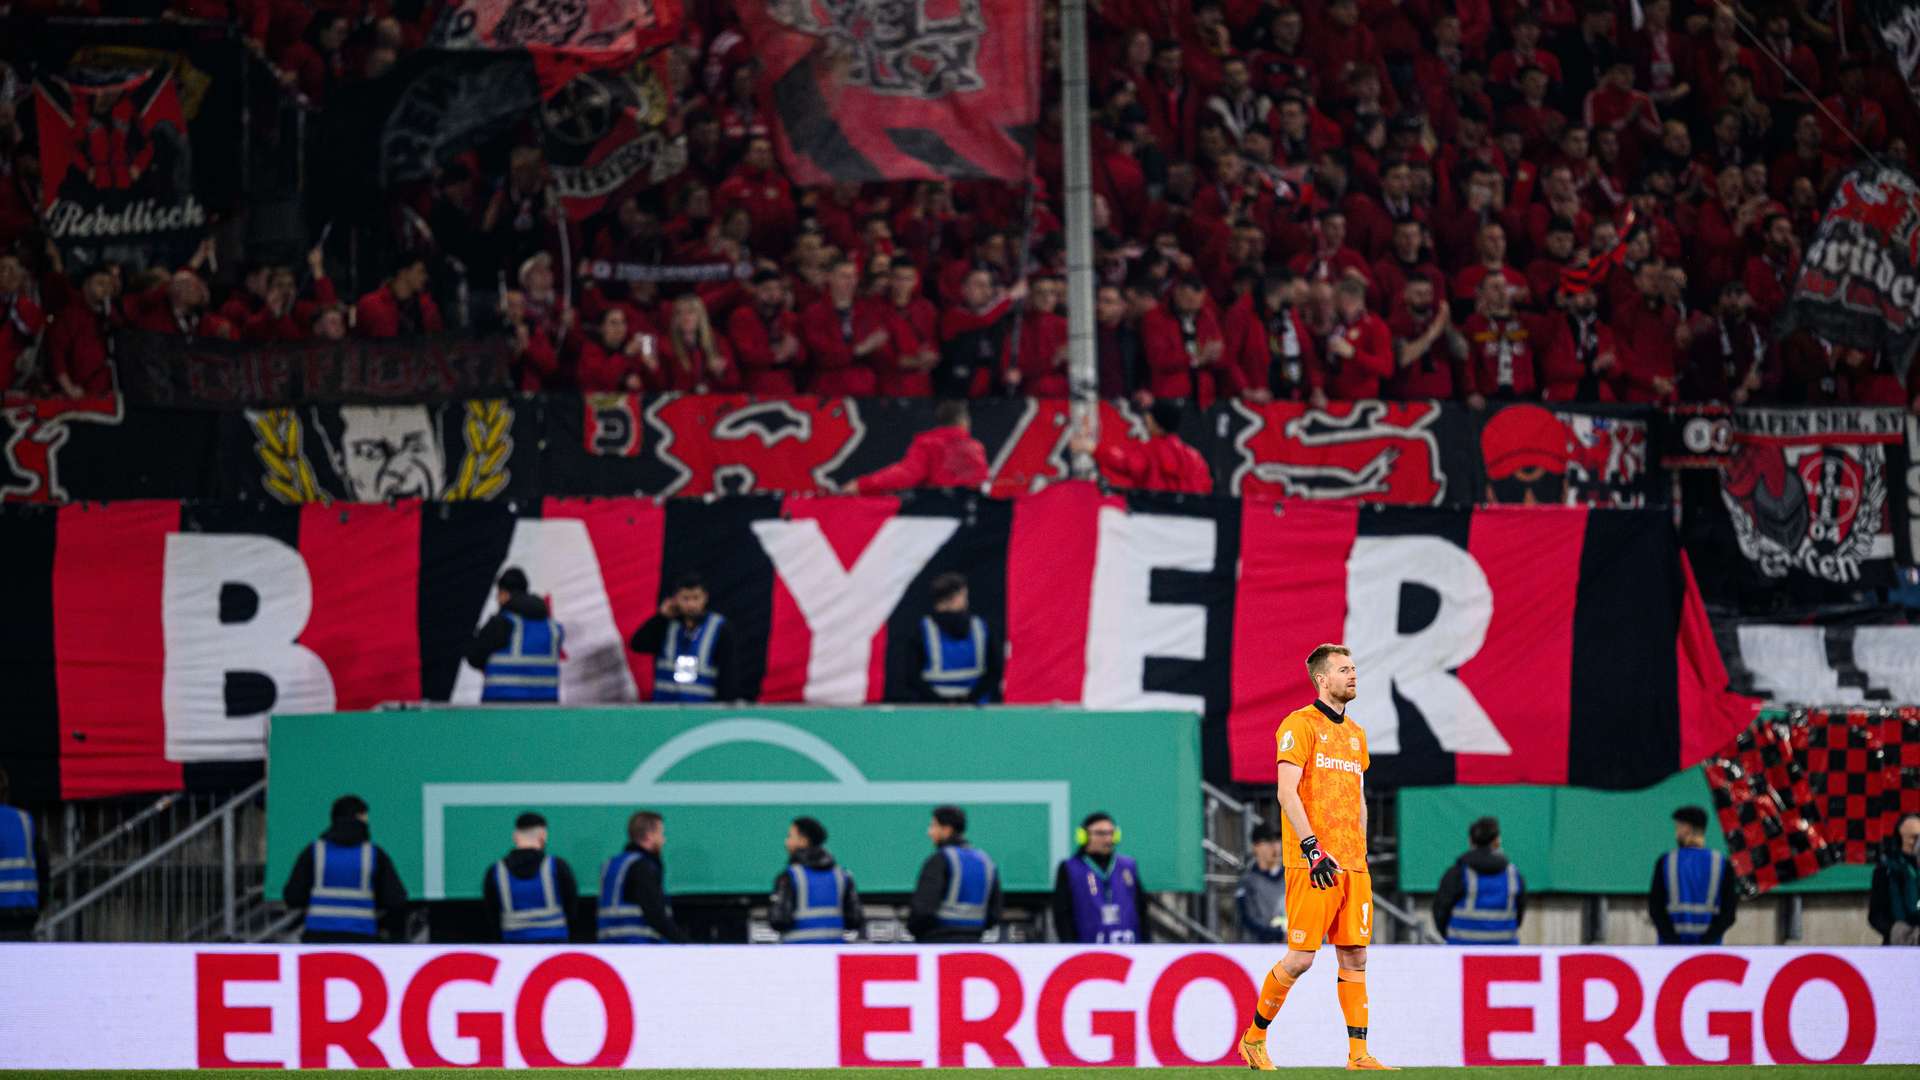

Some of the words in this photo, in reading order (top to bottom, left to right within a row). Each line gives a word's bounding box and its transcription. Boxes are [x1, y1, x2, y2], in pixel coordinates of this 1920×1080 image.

[47, 195, 206, 239] Rebellisch
[1809, 521, 1841, 544] 04
[162, 506, 1511, 762] BAYER
[1316, 752, 1362, 775] Barmenia
[196, 953, 633, 1068] ERGO
[838, 953, 1259, 1067] ERGO
[1463, 953, 1876, 1065] ERGO
